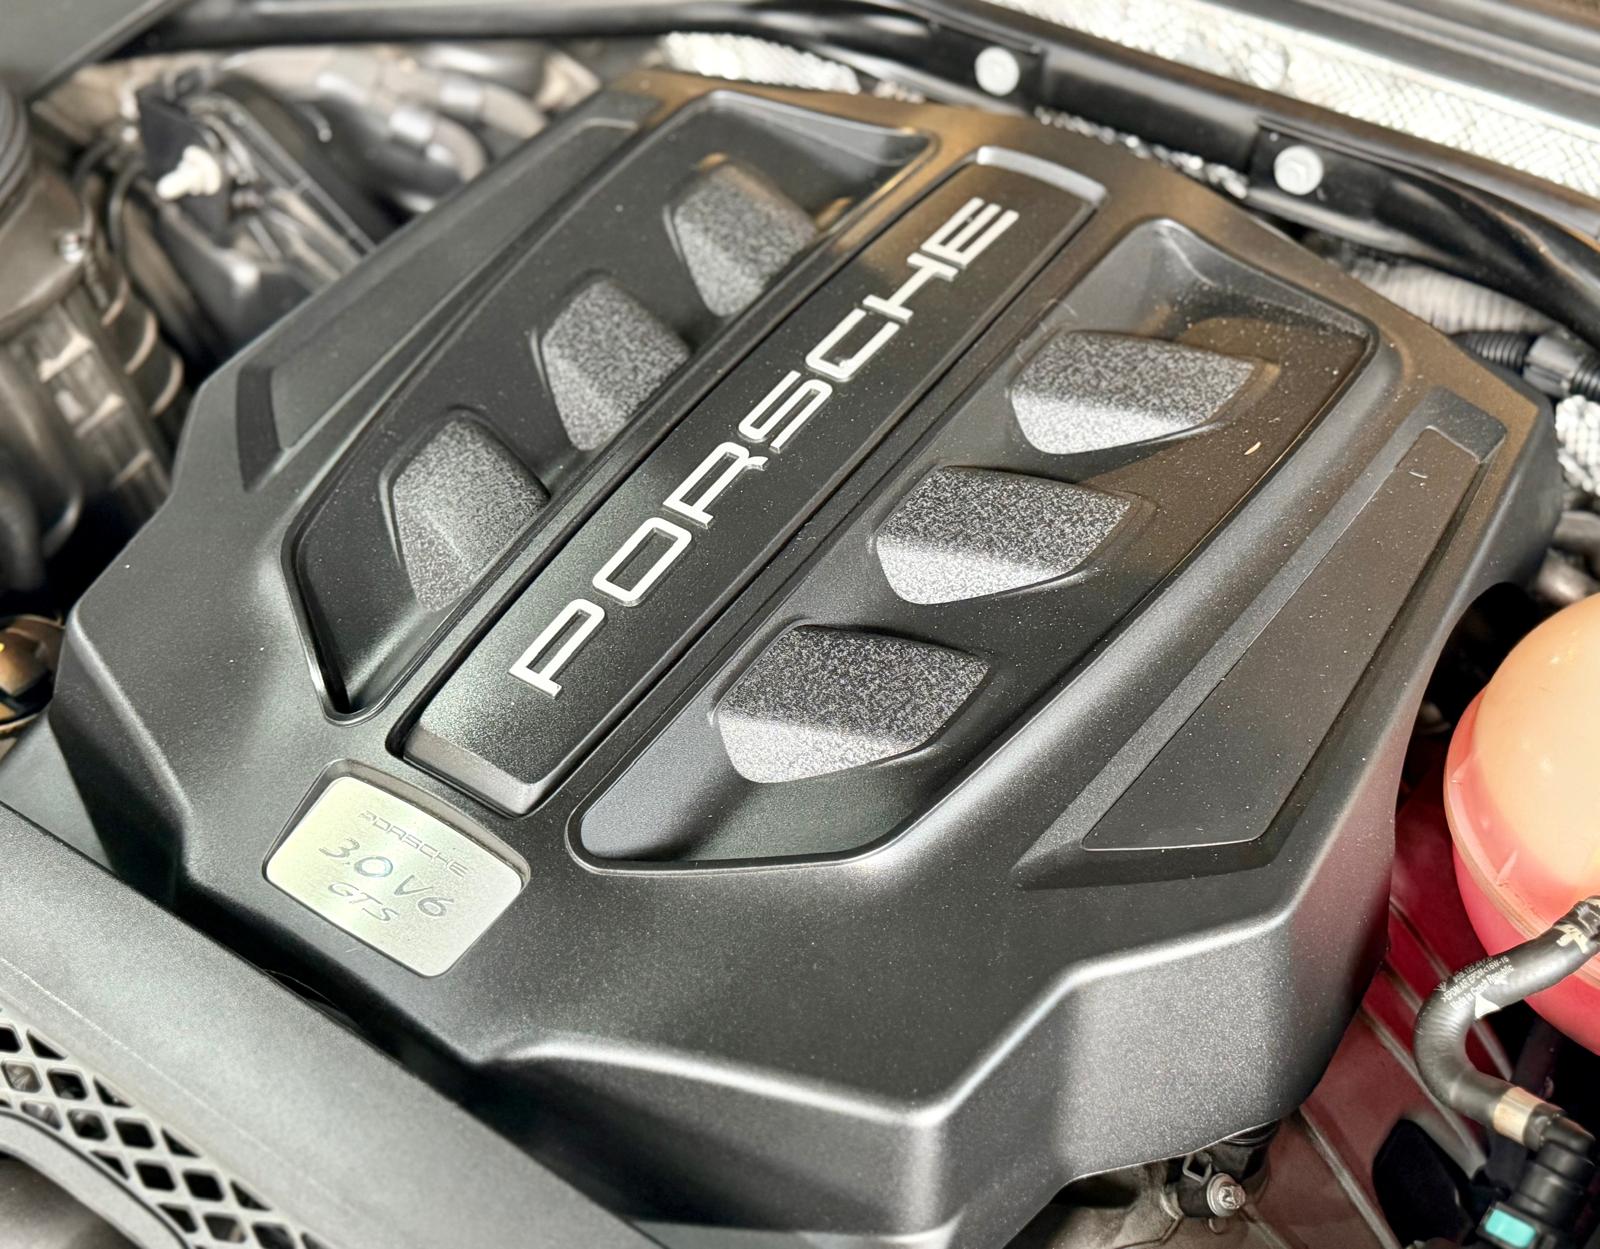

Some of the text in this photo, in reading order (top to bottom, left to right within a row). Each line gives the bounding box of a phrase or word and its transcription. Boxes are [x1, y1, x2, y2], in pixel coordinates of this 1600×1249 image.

[508, 197, 1019, 698] PORSCHE
[319, 838, 456, 917] 3.0 V6
[359, 810, 470, 878] PORSCHE
[327, 882, 400, 922] GTS
[1486, 964, 1514, 985] Republic
